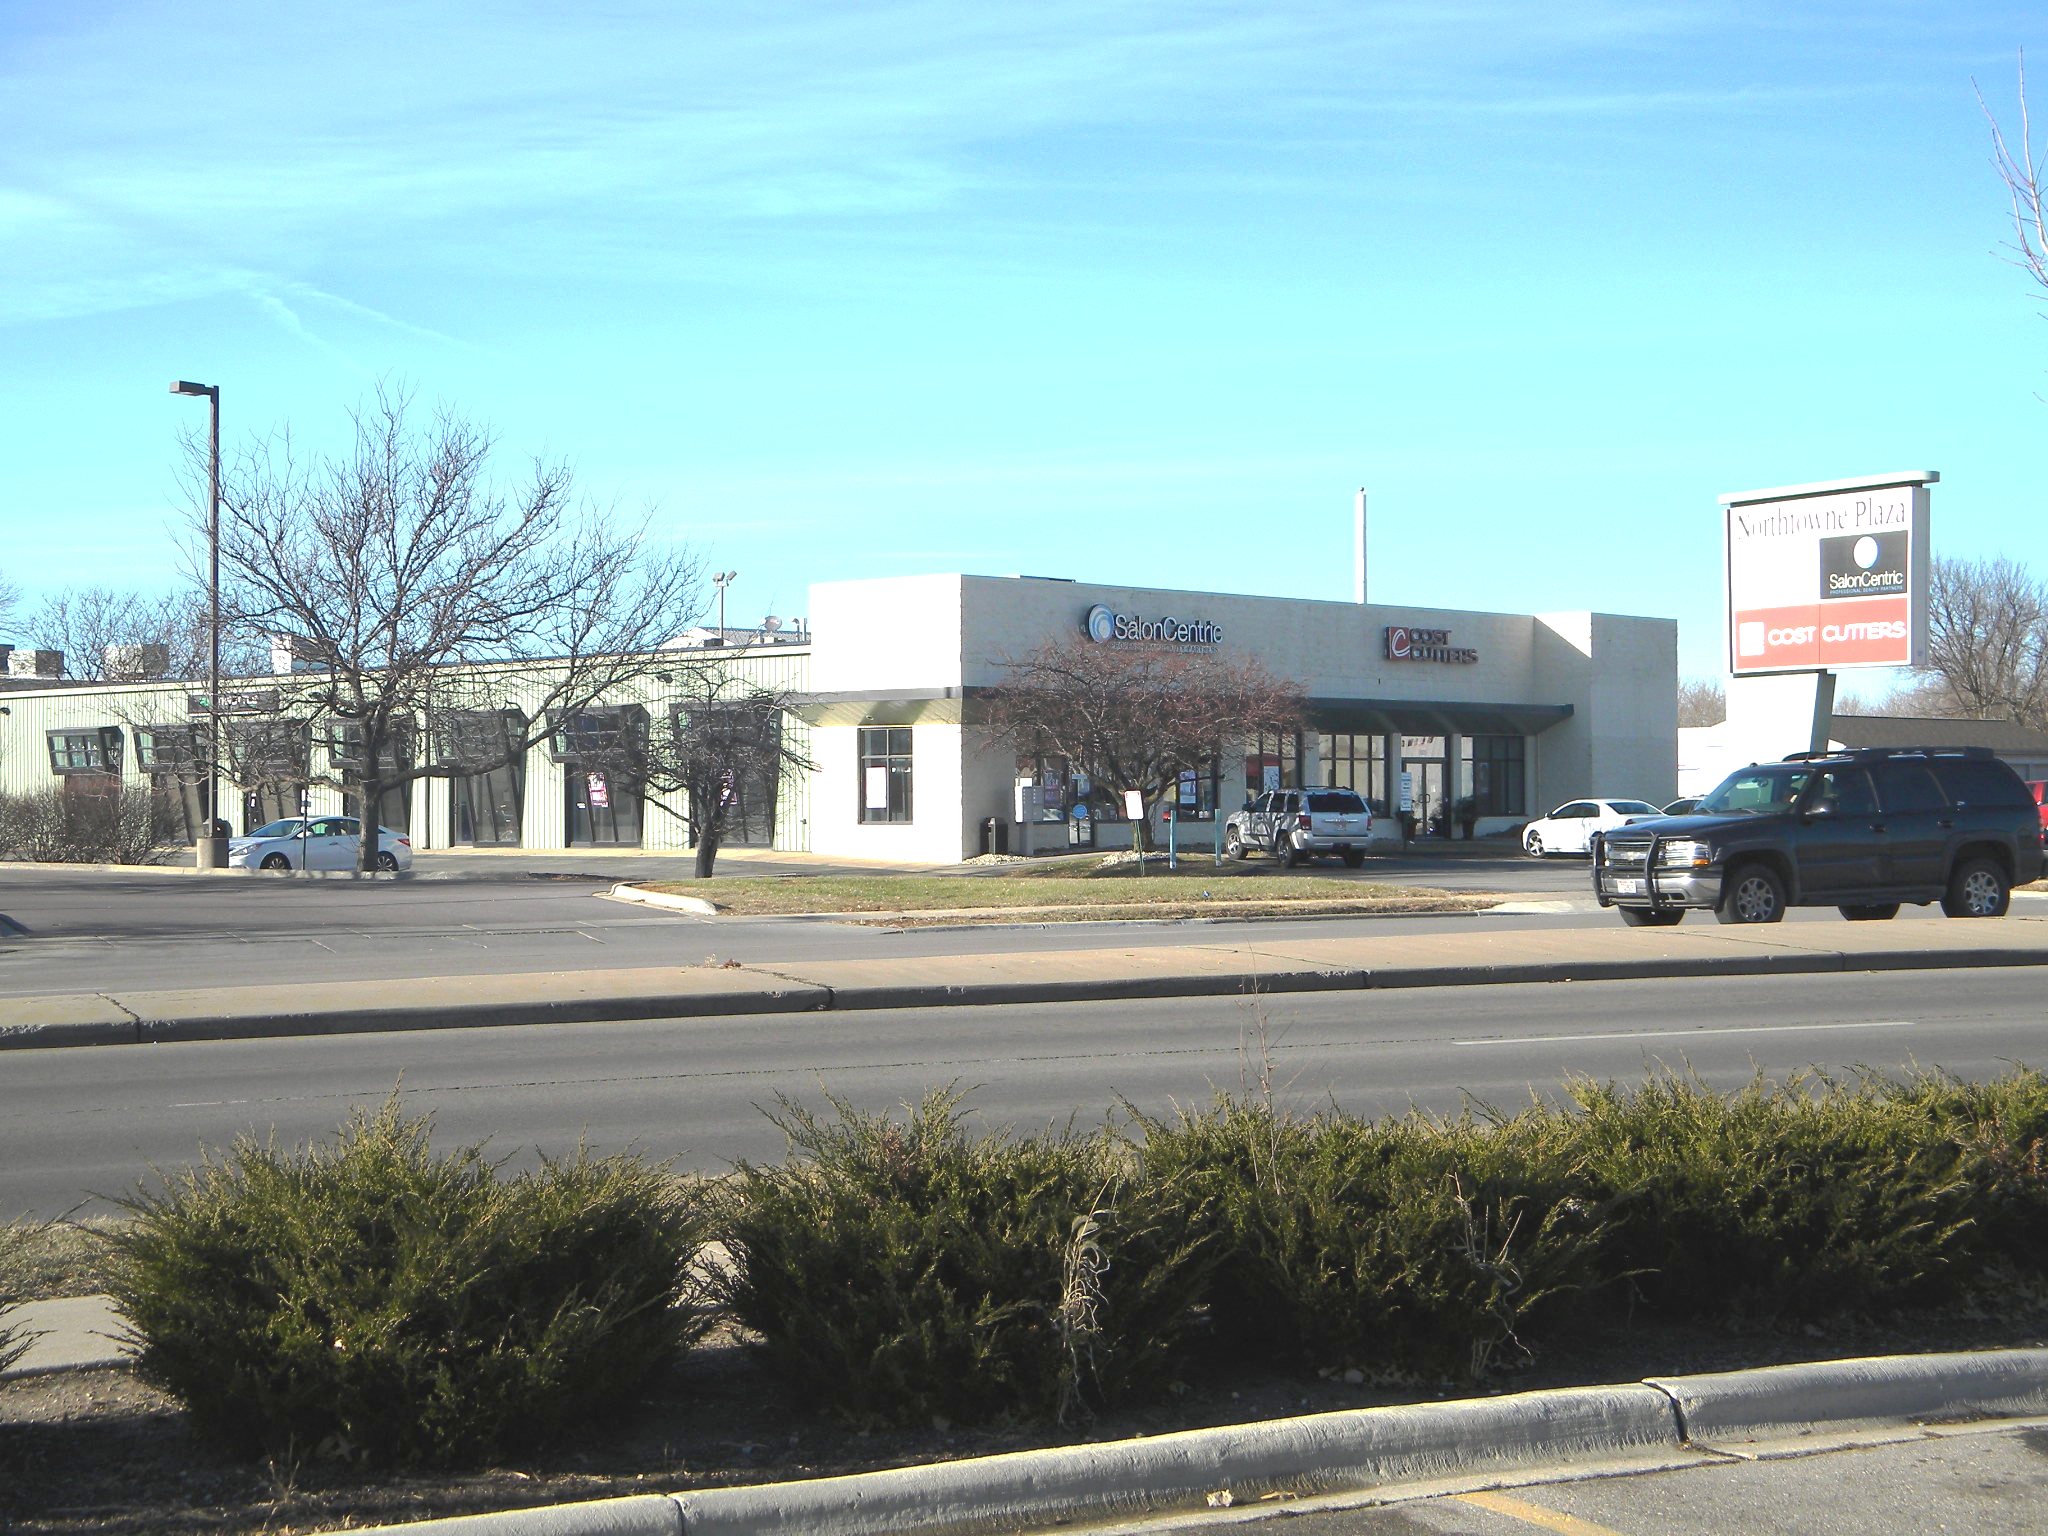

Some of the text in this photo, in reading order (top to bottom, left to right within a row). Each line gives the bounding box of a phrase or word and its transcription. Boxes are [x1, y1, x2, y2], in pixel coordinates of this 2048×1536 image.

[1855, 498, 1905, 527] Plaza
[1829, 570, 1904, 590] SalonCentric
[1115, 614, 1223, 644] SalonCentric
[1410, 628, 1452, 645] COST
[1767, 620, 1907, 647] COST CUTTERS
[1410, 646, 1479, 664] CUTTERS
